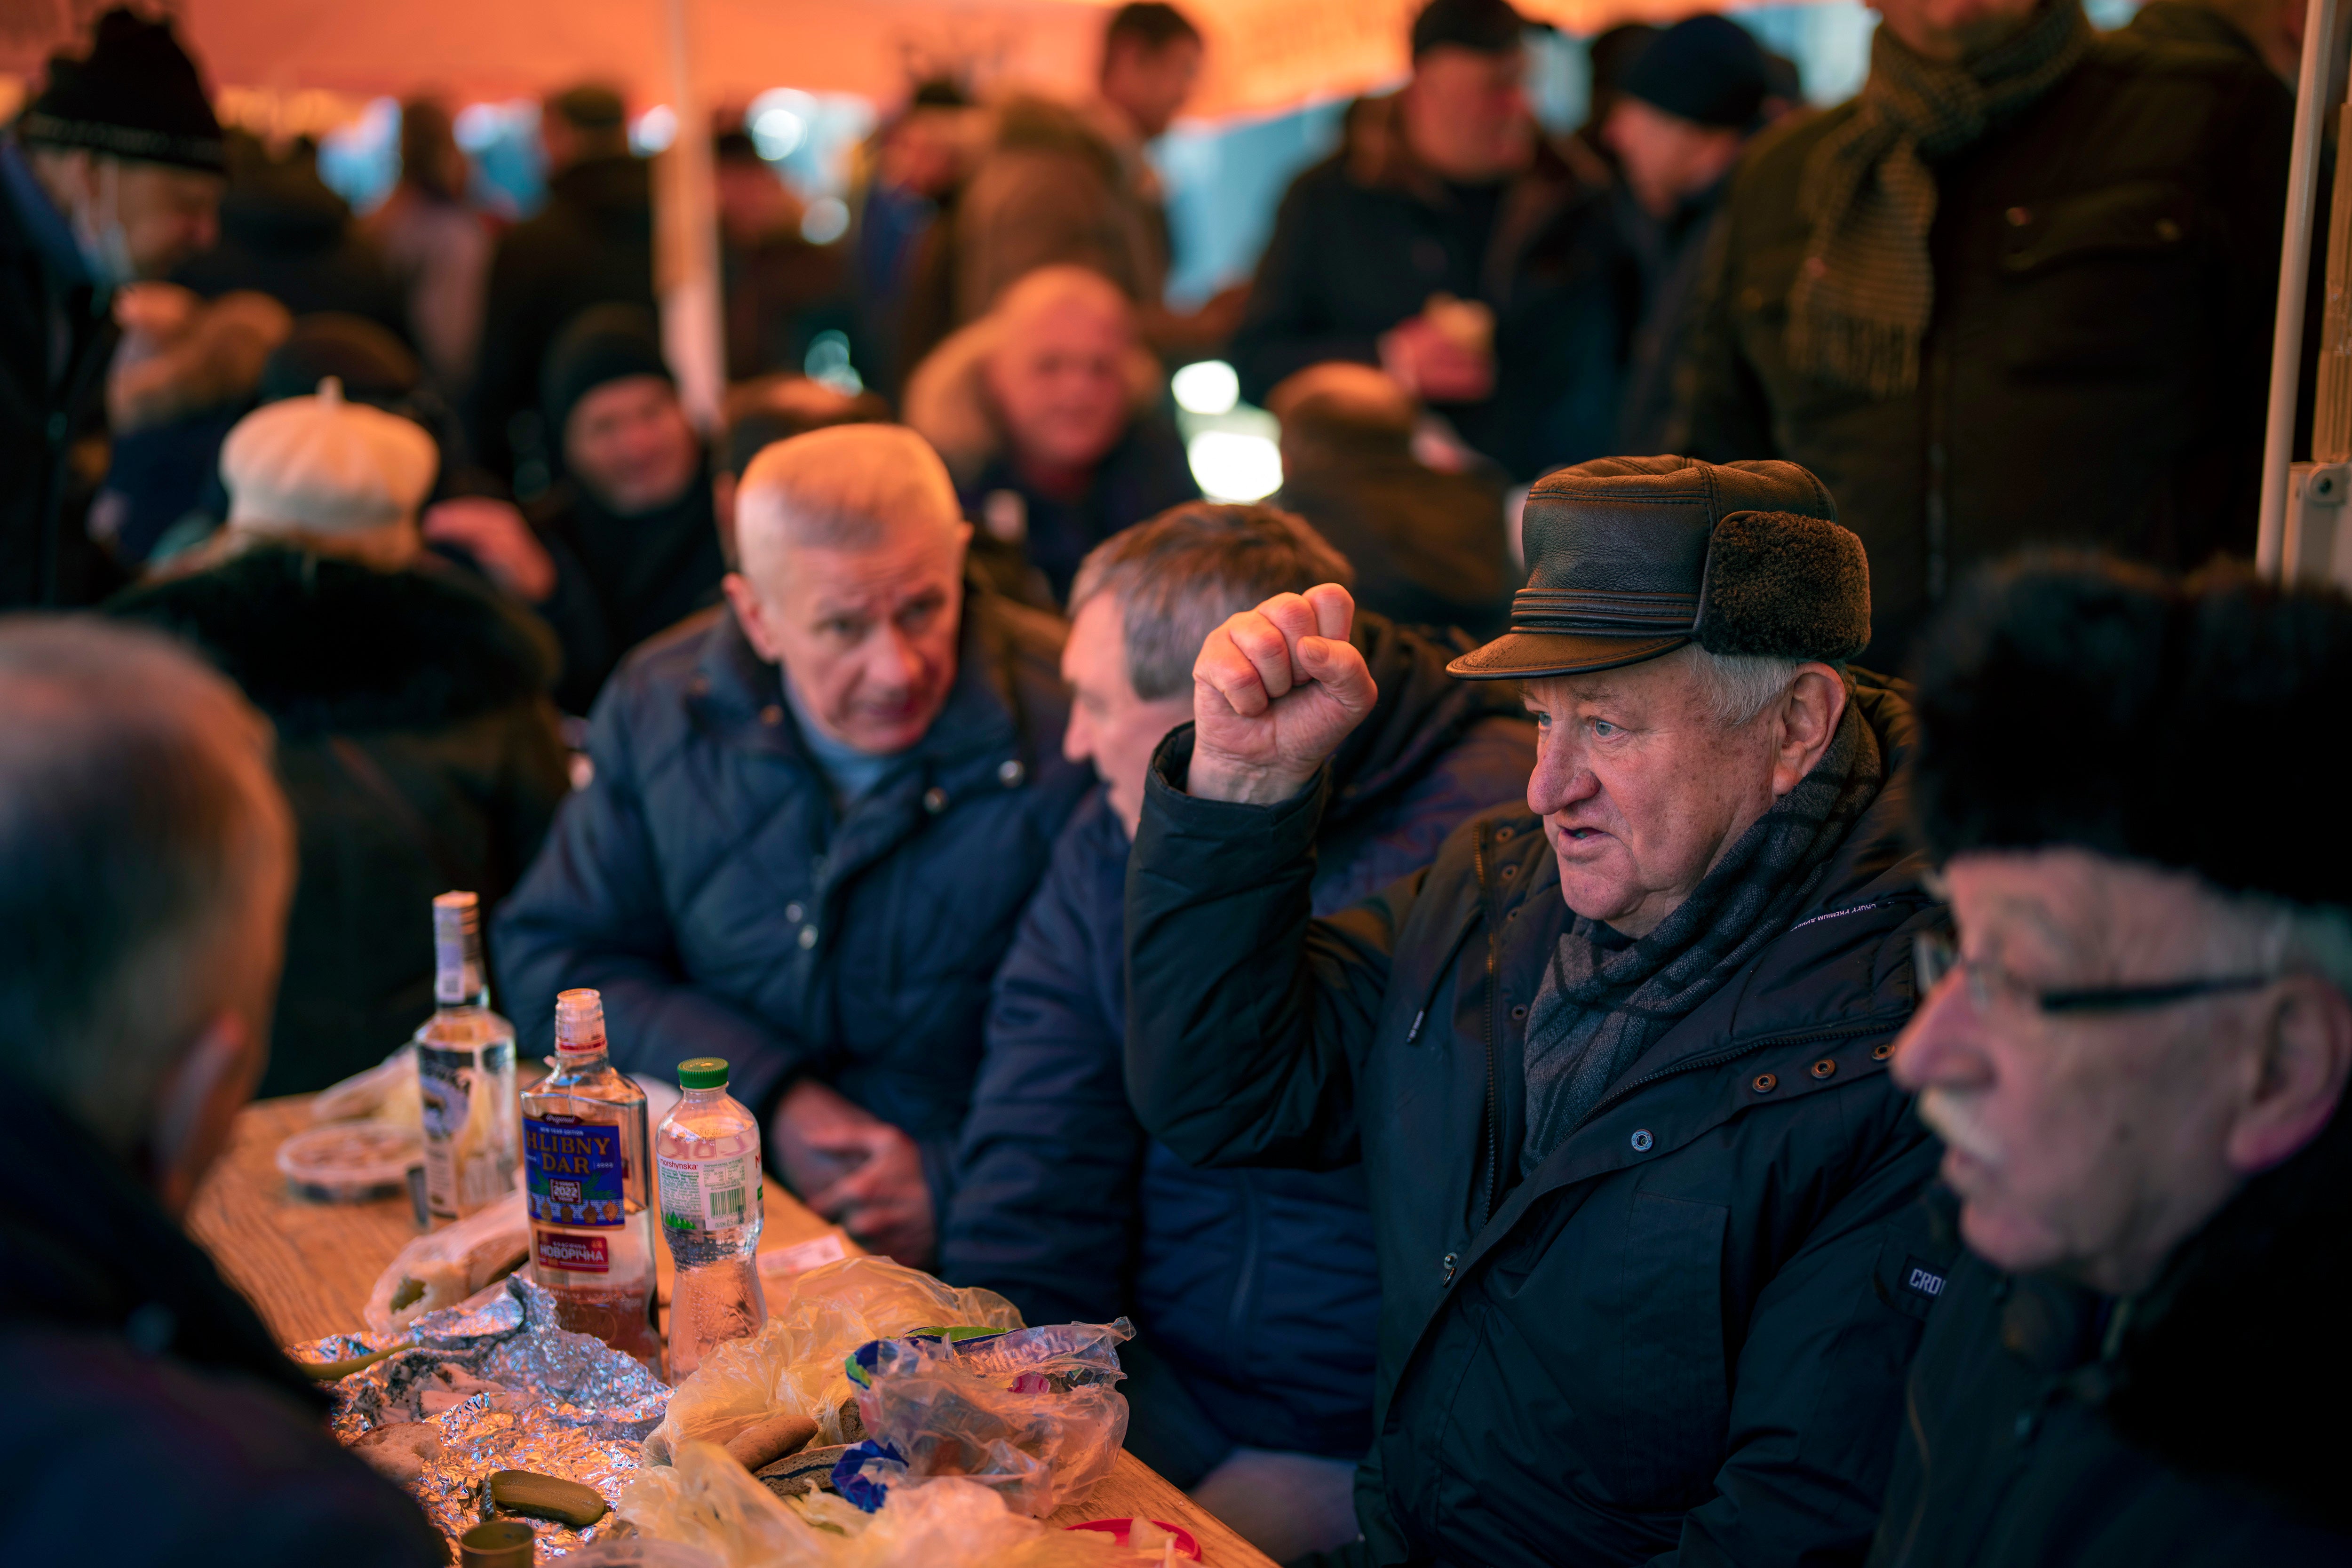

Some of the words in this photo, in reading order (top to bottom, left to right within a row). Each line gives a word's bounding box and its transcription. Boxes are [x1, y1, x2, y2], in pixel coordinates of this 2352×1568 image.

[546, 1114, 575, 1124] Original
[526, 1130, 611, 1155] HLIBNY
[542, 1152, 590, 1174] DAR
[660, 1158, 697, 1170] morshynska
[554, 1186, 578, 1198] 2022
[540, 1244, 604, 1262] НОВОРІЧНА
